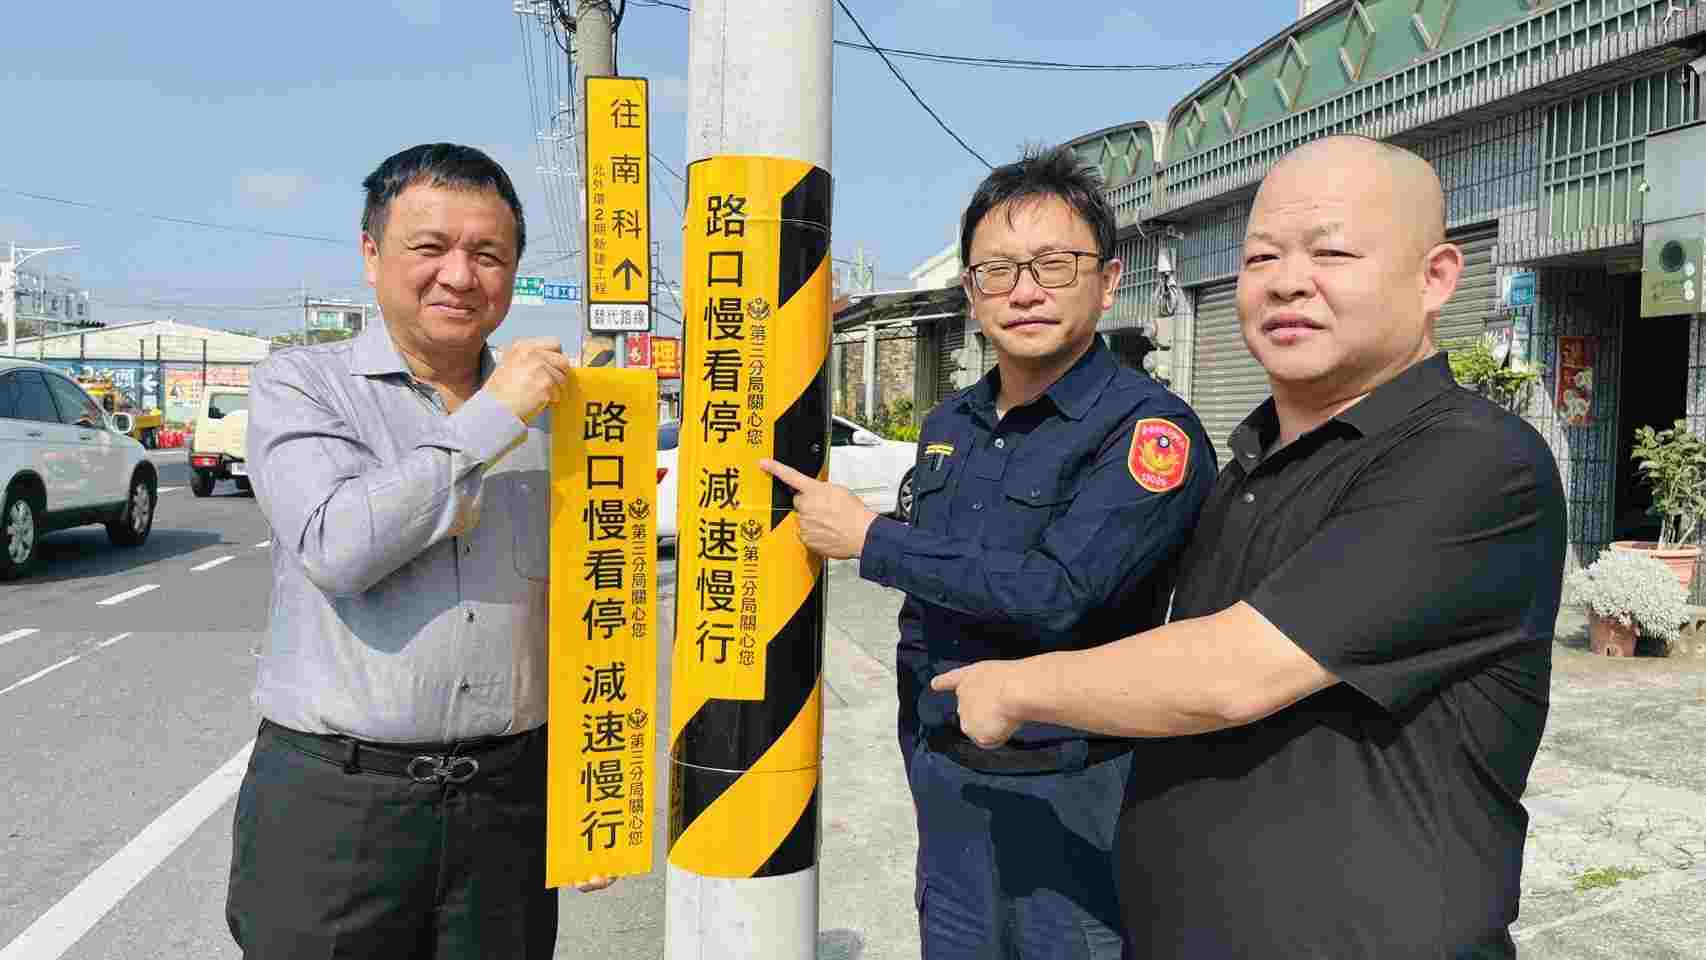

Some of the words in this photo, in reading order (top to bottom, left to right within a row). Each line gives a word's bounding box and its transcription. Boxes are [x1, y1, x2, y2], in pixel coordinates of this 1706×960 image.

[610, 98, 642, 240] 往南科
[701, 194, 748, 443] 路口慢看停
[746, 322, 769, 446] 第三分局關心您
[582, 401, 628, 641] 路口慢看停
[631, 523, 648, 640] 第三分局關心您
[696, 467, 741, 665] 減速慢行
[738, 545, 759, 666] 第三分局關心您
[580, 662, 627, 852] 減速慢行
[628, 733, 645, 847] 第三分局關心您
